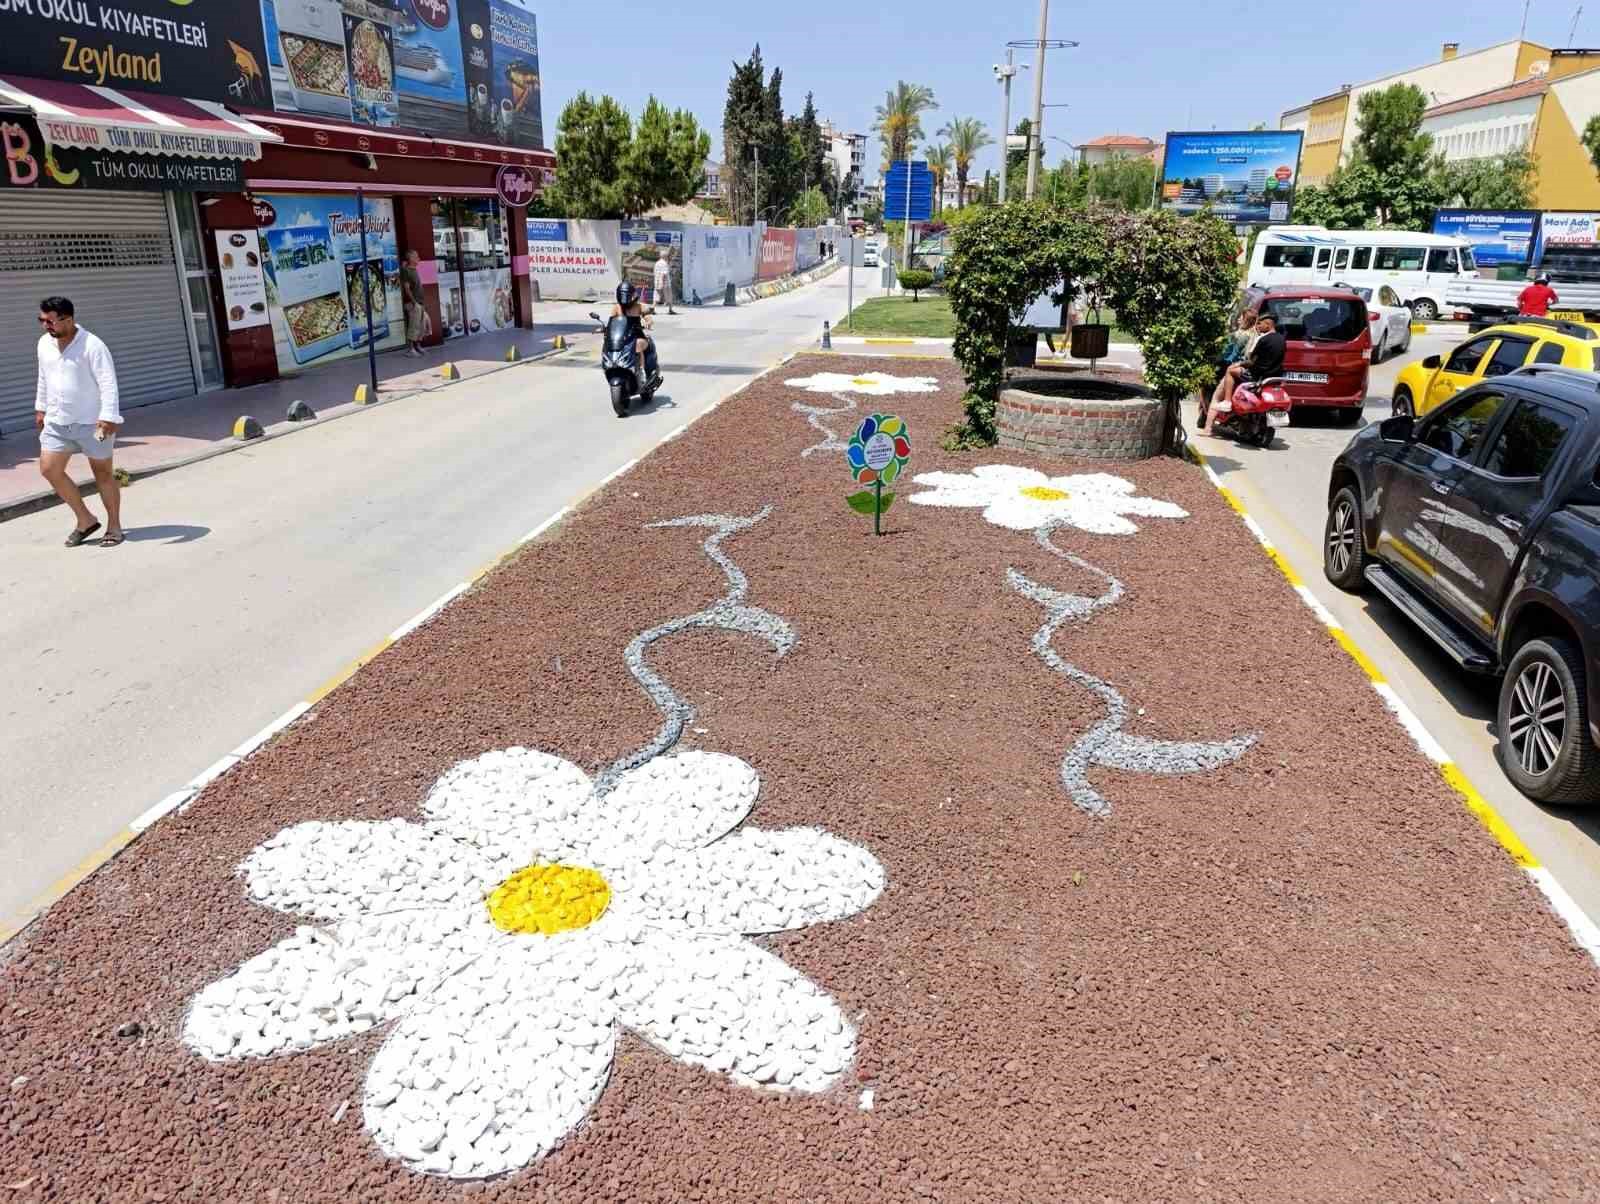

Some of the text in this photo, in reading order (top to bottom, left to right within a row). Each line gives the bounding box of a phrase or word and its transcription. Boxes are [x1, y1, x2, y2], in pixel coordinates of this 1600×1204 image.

[37, 0, 97, 27] OKUL
[99, 5, 208, 49] KIYAFETLERİ
[59, 36, 162, 85] Zeyland
[47, 123, 99, 144] ZEYLAND
[106, 126, 130, 146] TÜM
[134, 130, 159, 150] OKUL
[160, 133, 216, 155] KIYAFETLERİ
[92, 159, 238, 183] TÜM OKUL KIYAFETLERİ
